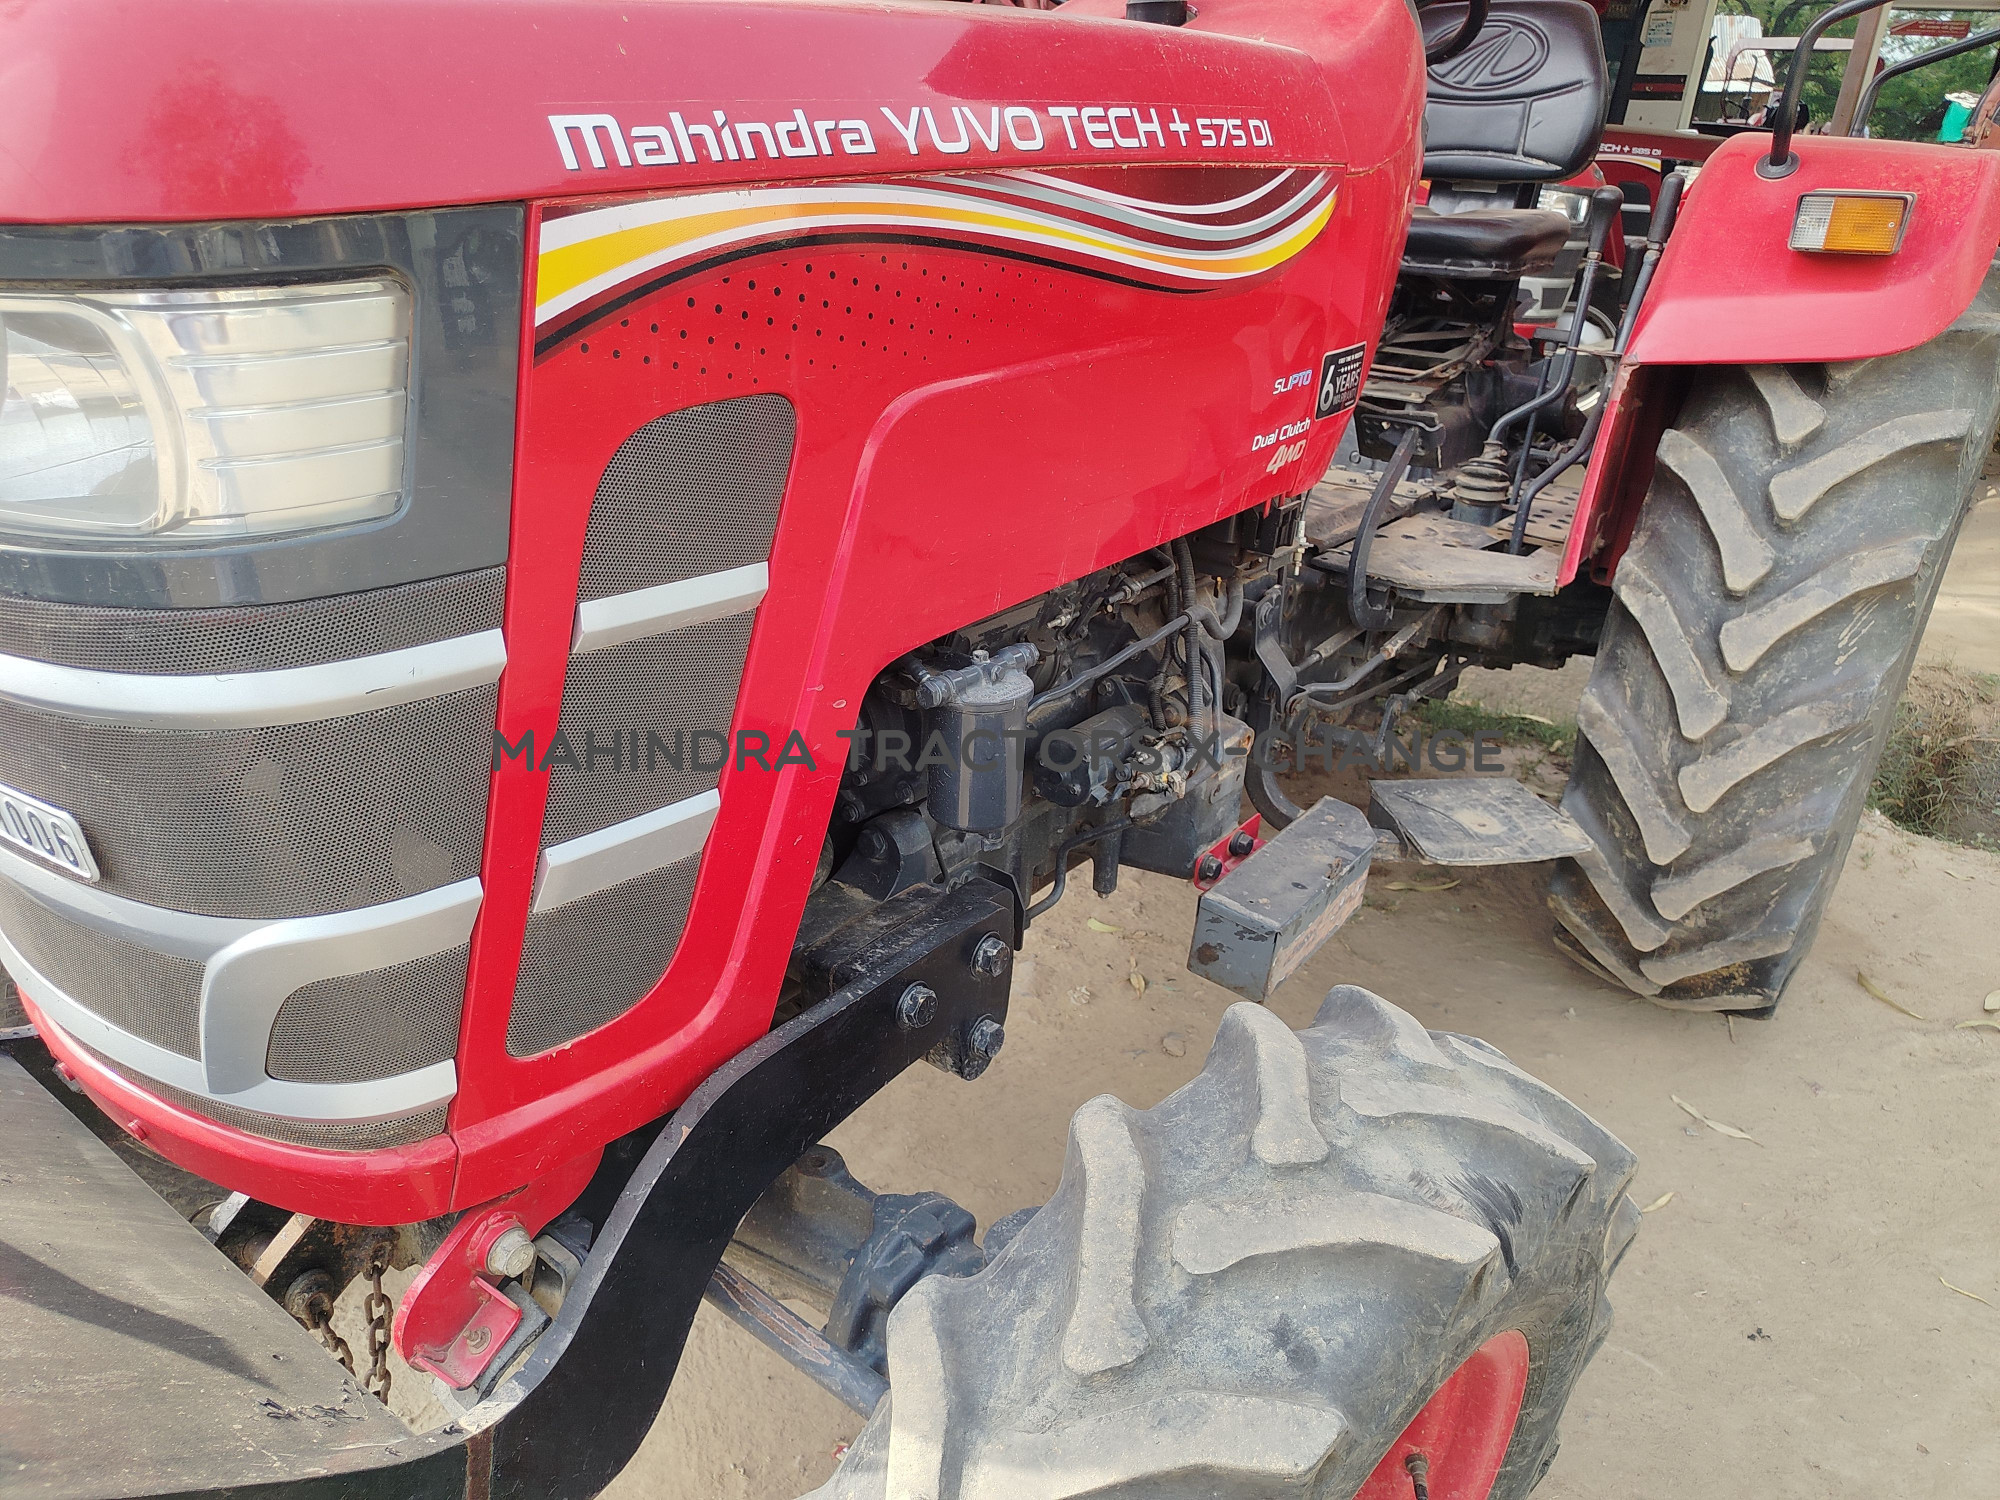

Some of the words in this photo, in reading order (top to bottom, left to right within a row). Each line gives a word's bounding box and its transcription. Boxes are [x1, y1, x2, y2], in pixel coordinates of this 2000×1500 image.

[547, 108, 878, 171] Mahindra
[879, 106, 1045, 155] YUVO
[1196, 118, 1247, 147] 575
[1249, 119, 1274, 147] DI
[1599, 143, 1621, 153] ECH
[1319, 364, 1336, 412] 6
[1251, 428, 1279, 452] Dual
[1279, 417, 1311, 442] Clutch
[1265, 439, 1307, 475] 4WD
[0, 801, 80, 869] 006
